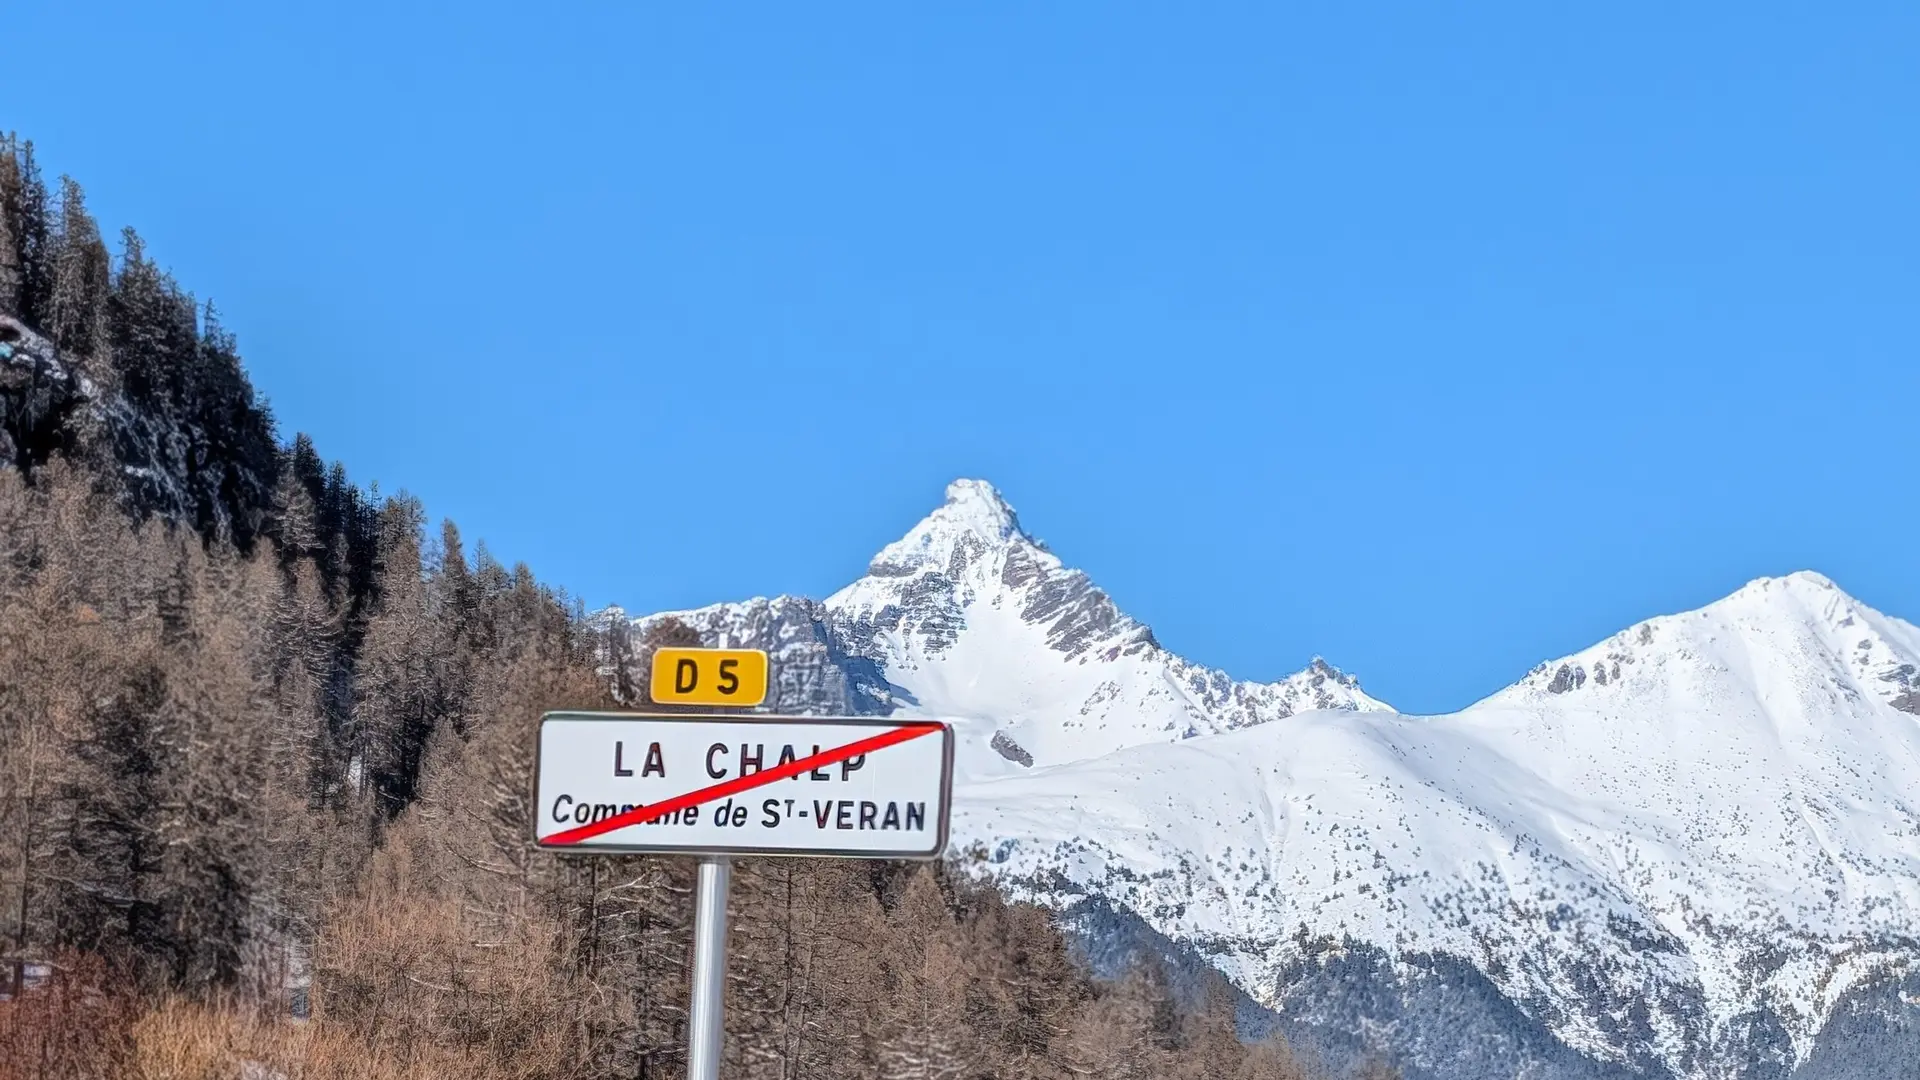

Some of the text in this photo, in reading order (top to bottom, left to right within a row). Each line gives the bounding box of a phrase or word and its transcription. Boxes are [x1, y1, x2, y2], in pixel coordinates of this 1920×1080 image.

[676, 658, 740, 694] D 5
[614, 740, 867, 782] LA CHALP
[714, 798, 747, 828] de
